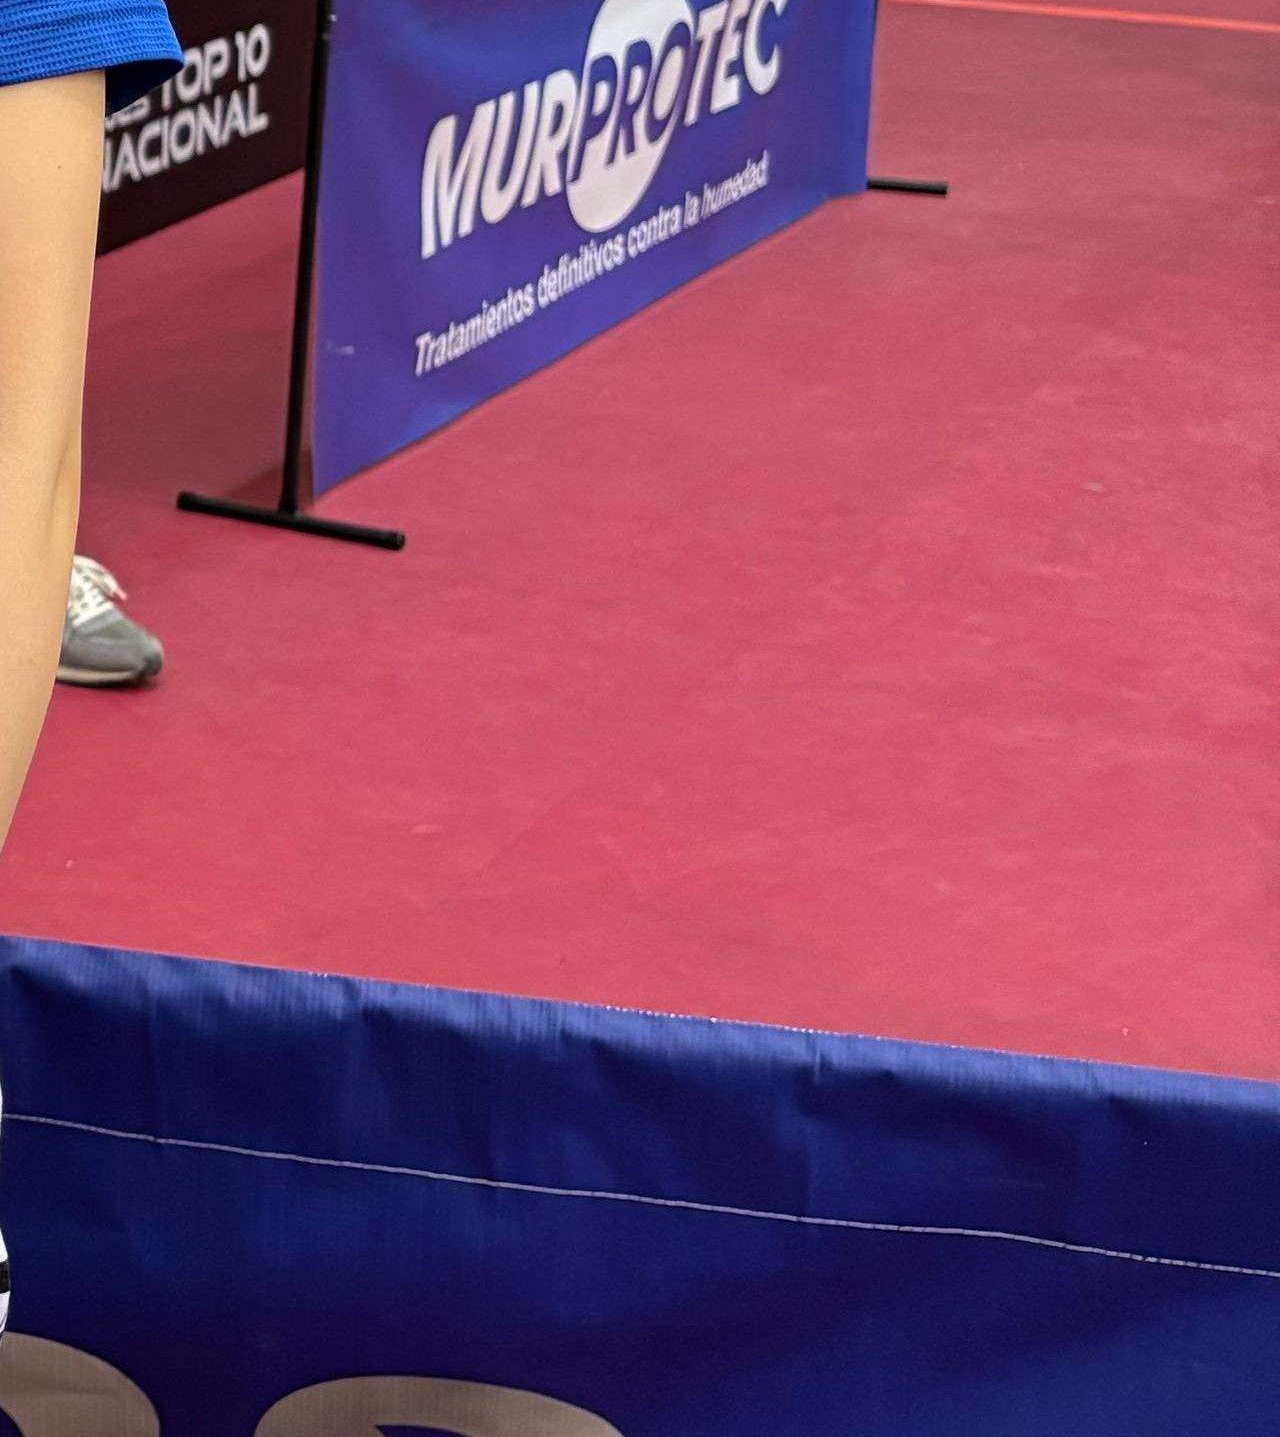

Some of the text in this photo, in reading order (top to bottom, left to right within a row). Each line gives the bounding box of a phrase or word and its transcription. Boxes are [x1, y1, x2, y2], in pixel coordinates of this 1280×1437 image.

[235, 23, 270, 82] 10
[415, 150, 769, 377] Tratamientos definitivos contra la humedad
